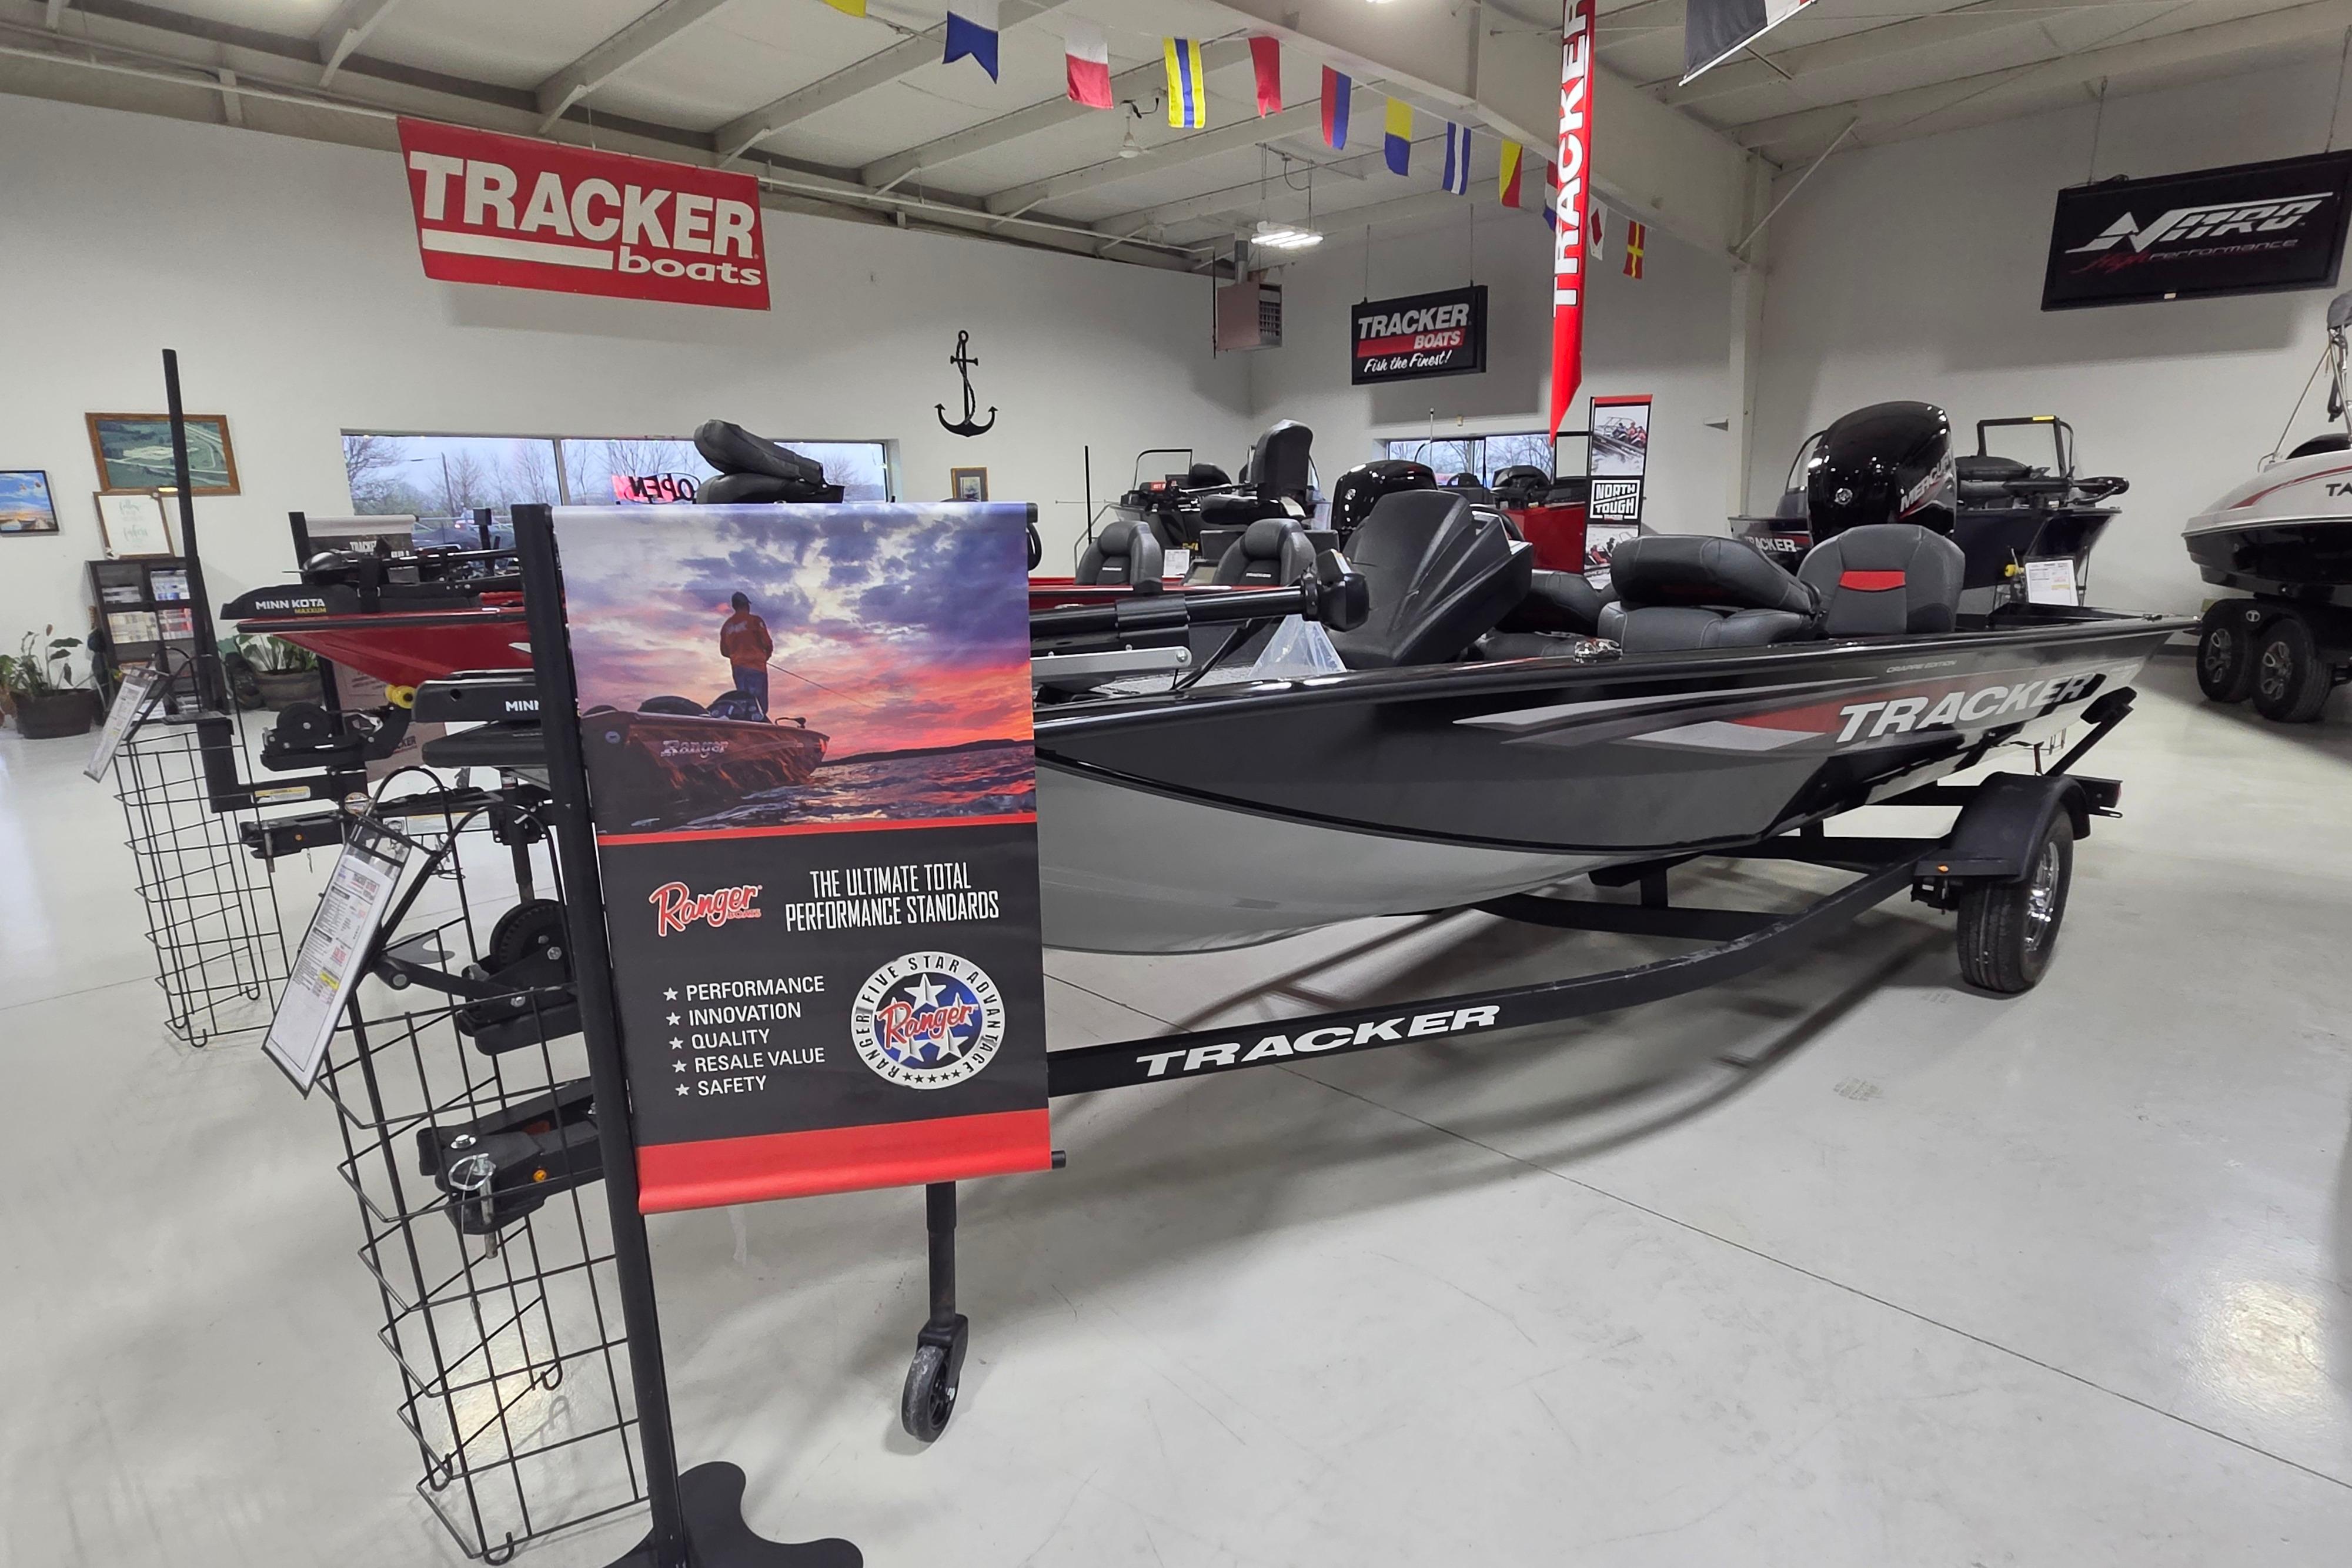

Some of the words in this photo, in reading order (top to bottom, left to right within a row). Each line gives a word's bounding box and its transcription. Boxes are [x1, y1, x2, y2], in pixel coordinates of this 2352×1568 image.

[409, 151, 756, 259] TRACKER
[618, 245, 761, 286] boats
[1358, 303, 1469, 339] TRACKER
[1414, 330, 1461, 349] BOATS
[1364, 356, 1388, 373] Fish
[1389, 355, 1408, 370] the
[1409, 350, 1452, 368] Finest!
[1596, 484, 1636, 500] NORTH
[1596, 498, 1634, 514] TOUGH
[255, 600, 289, 610] MINN
[291, 598, 325, 608] KOTA
[1836, 672, 2096, 743] TRACKER
[810, 869, 840, 898] THE
[845, 864, 919, 896] ULTIMATE
[923, 861, 972, 891] TOTAL
[649, 881, 763, 937] Ranger
[785, 898, 902, 932] PERFORMANCE
[907, 890, 1000, 925] STANDARDS
[908, 955, 960, 974] STAR
[685, 974, 826, 1001] PERFORMANCE
[862, 965, 899, 1004] FIVE
[688, 999, 802, 1026] INNOVATION
[877, 1001, 978, 1049] Ranger
[963, 971, 1001, 1074] ADVANTAGE
[691, 1026, 771, 1050] QUALITY
[855, 1014, 900, 1078] RANGER
[1136, 1005, 1501, 1077] TRACKER
[694, 1051, 765, 1074] RESALE
[768, 1045, 826, 1069] VALUE
[697, 1071, 767, 1096] SAFETY
